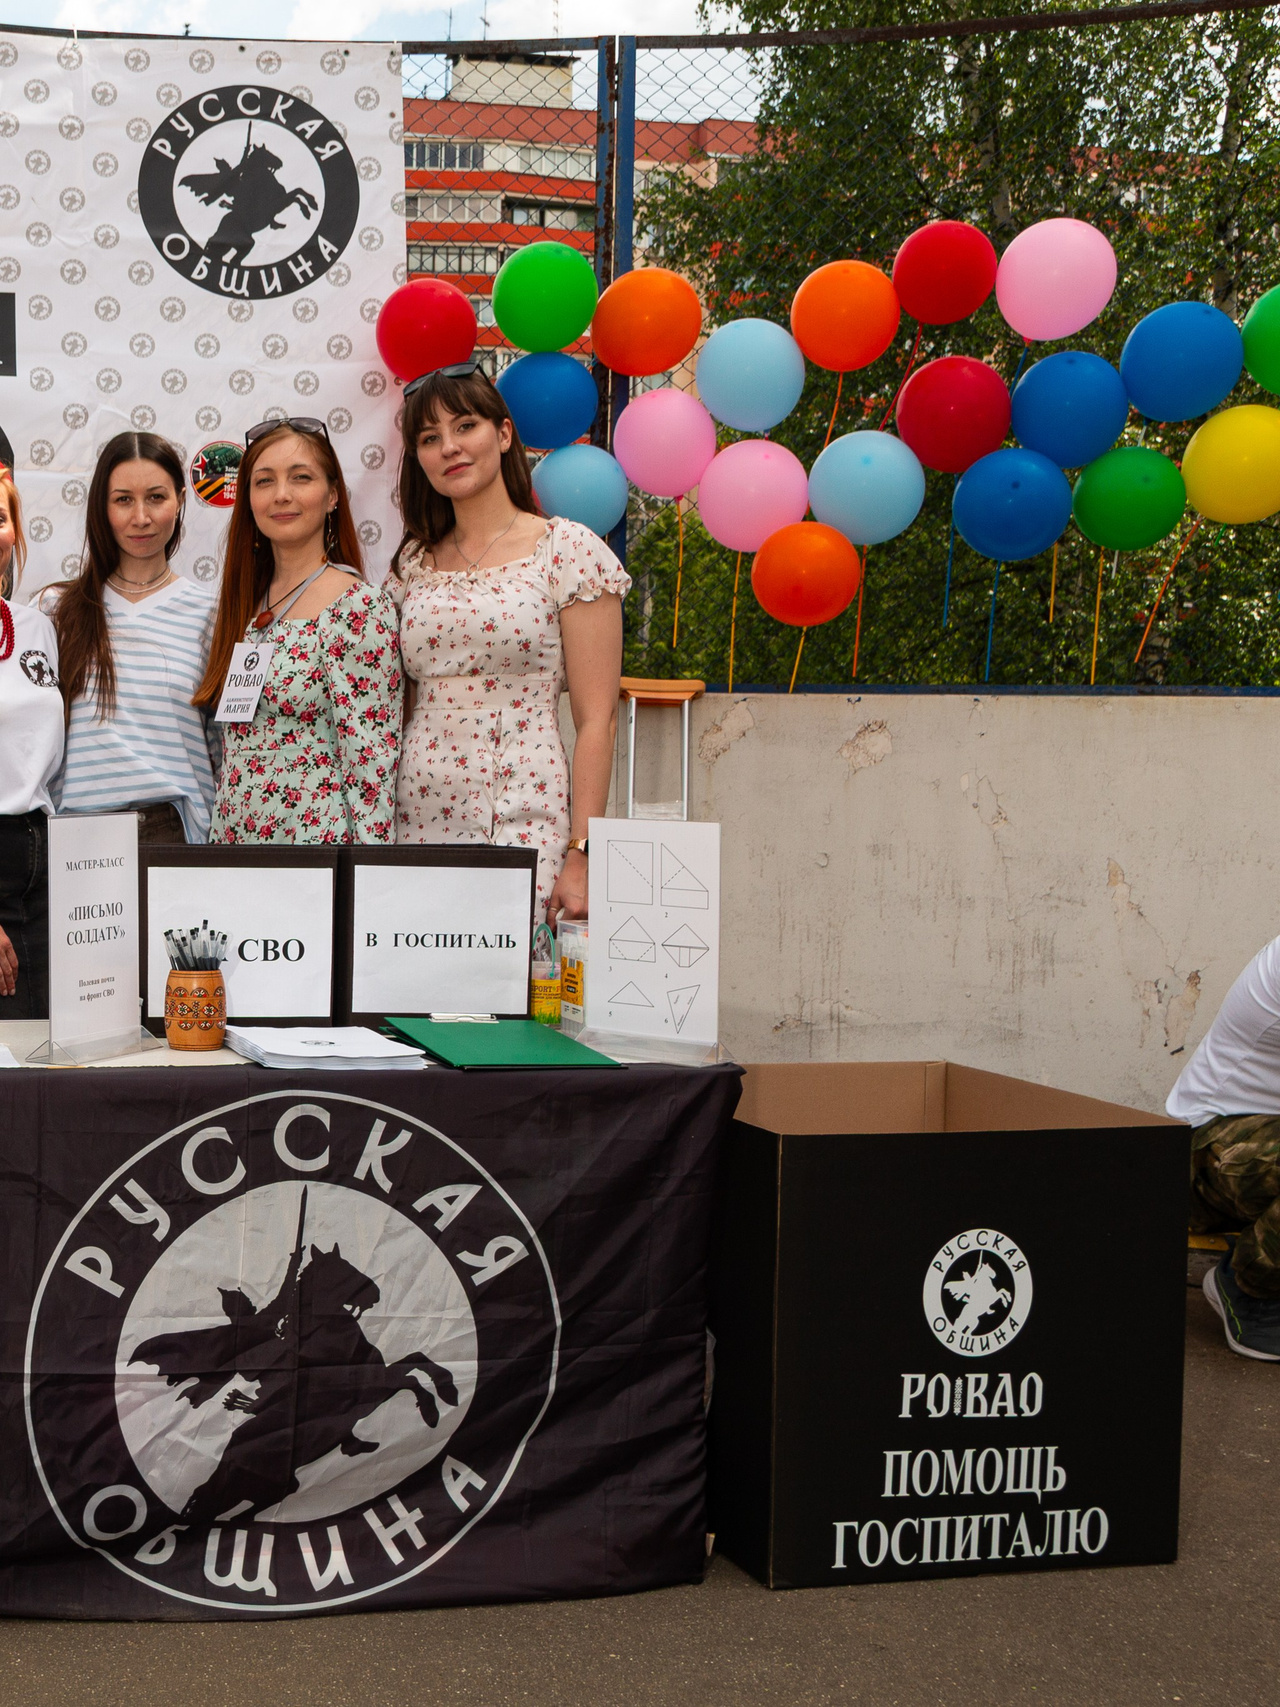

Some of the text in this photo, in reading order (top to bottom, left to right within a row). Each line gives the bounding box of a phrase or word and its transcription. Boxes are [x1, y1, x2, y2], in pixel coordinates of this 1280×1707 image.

[152, 88, 344, 161] РУССКАЯ
[162, 233, 338, 297] ОБЩИНА
[223, 704, 251, 713] МАРИЯ
[65, 857, 125, 872] МАСТЕР-КЛАСС
[68, 902, 123, 921] «ПИСЬМО
[66, 926, 126, 946] СОЛДАТУ»
[237, 938, 305, 962] СВО
[365, 933, 517, 949] В ГОСПИТАЛЬ
[78, 976, 115, 988] Полевая почта
[79, 988, 115, 1003] на фронт СВО
[64, 1103, 529, 1298] РУССКАЯ
[933, 1230, 1026, 1273] РУССКАЯ
[933, 1316, 1019, 1353] ОБЩИНА
[881, 1446, 1067, 1504] ПОМОЩЬ
[83, 1455, 487, 1597] ОБЩИНА
[831, 1506, 1109, 1568] ГОСПИТАЛЮ
